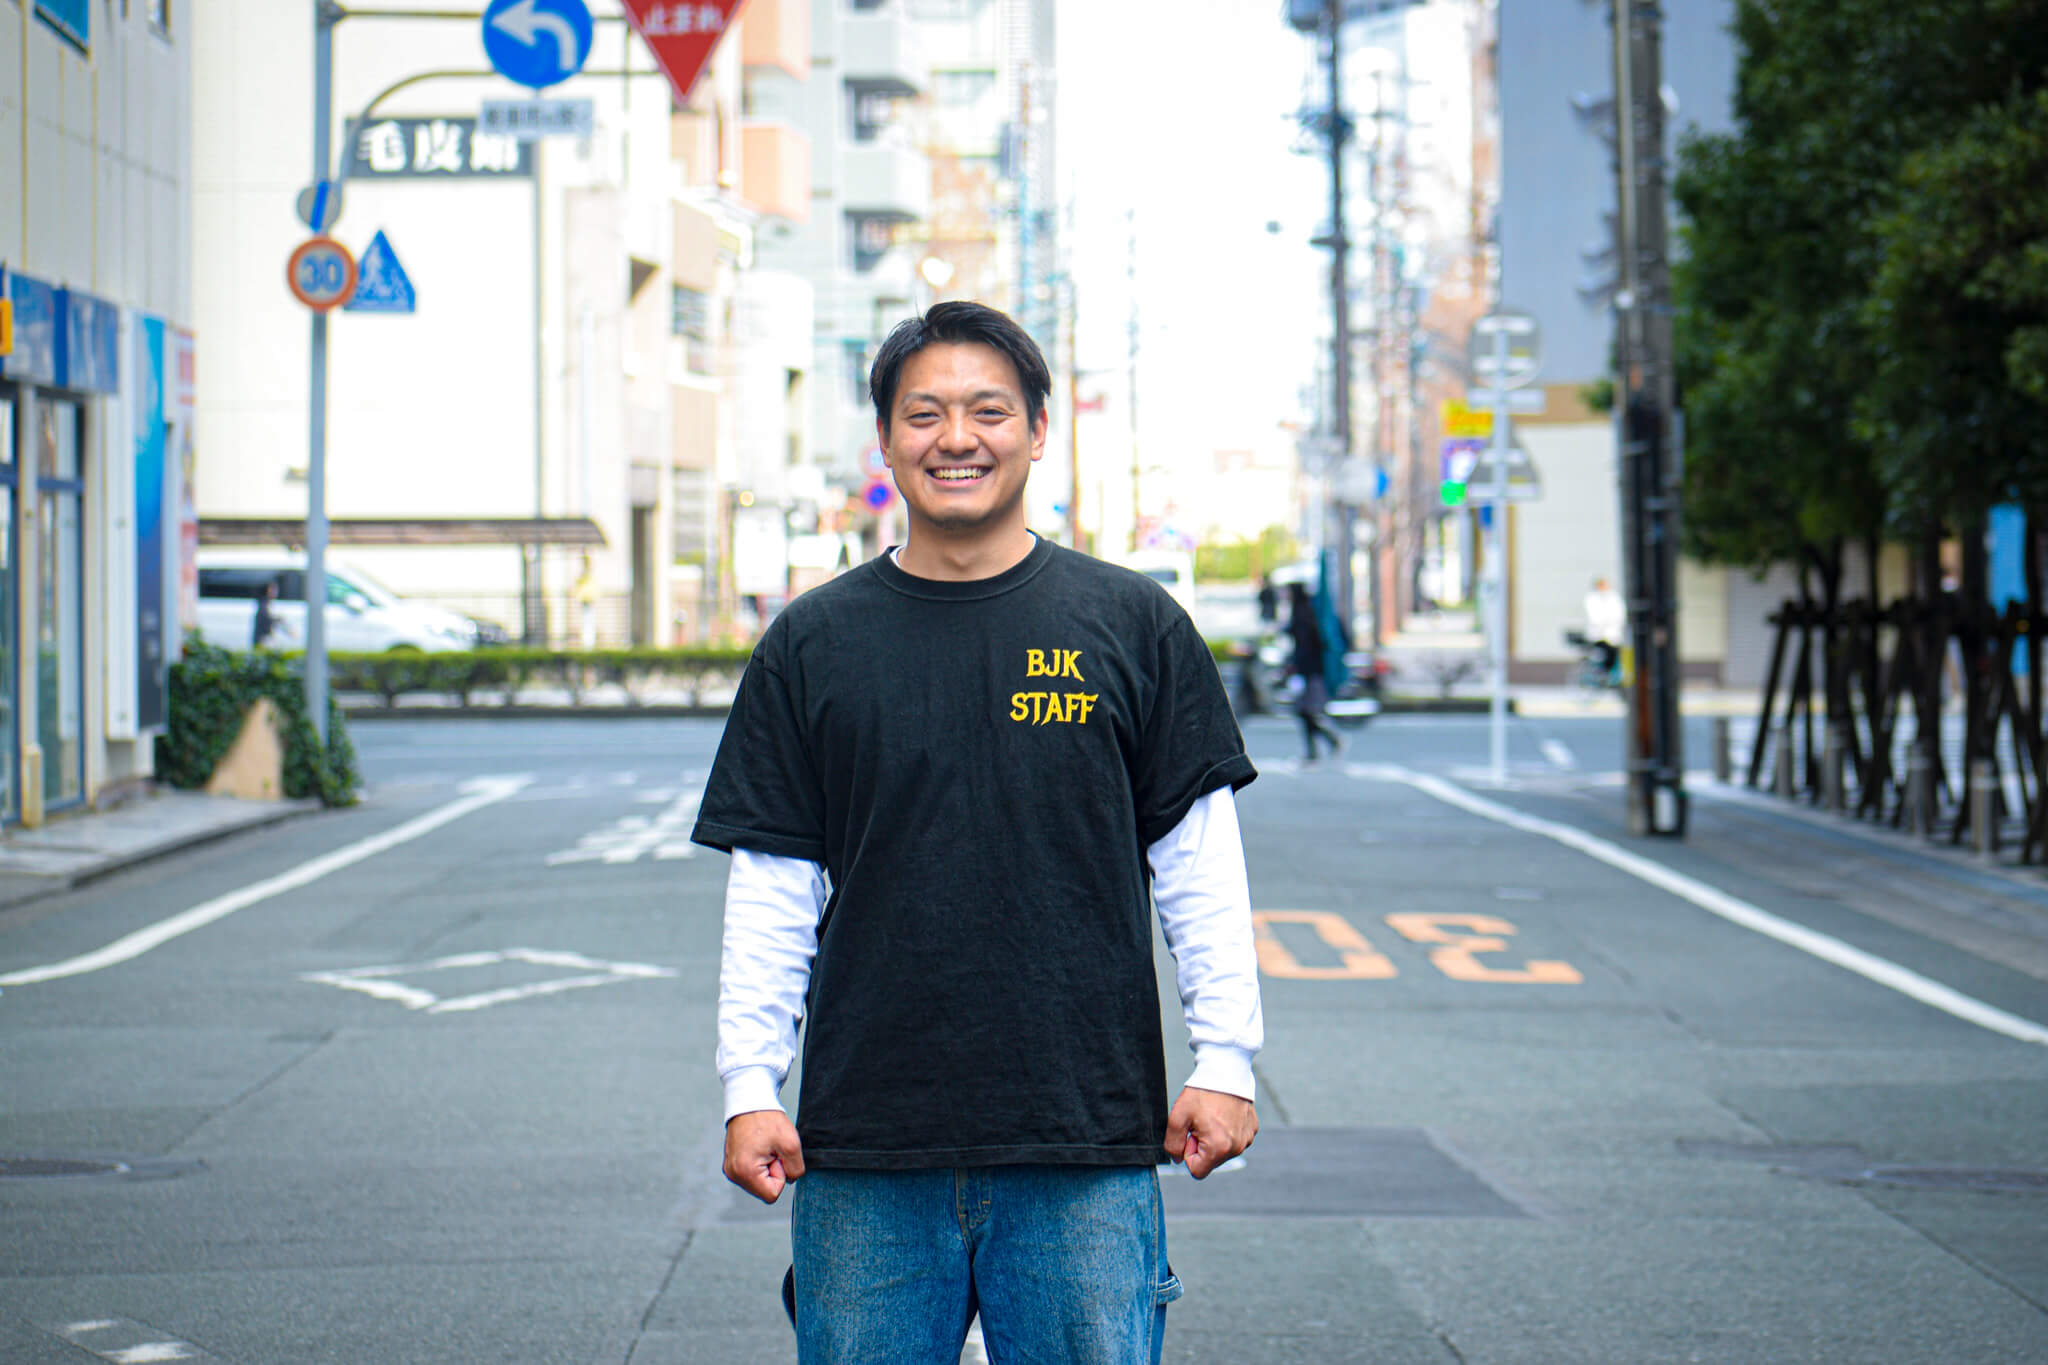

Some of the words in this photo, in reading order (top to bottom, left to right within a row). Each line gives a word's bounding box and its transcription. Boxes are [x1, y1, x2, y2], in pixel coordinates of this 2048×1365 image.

[643, 3, 723, 36] 止まれ
[298, 254, 344, 295] 30
[1026, 648, 1085, 682] BJK
[1009, 691, 1099, 726] STAFF
